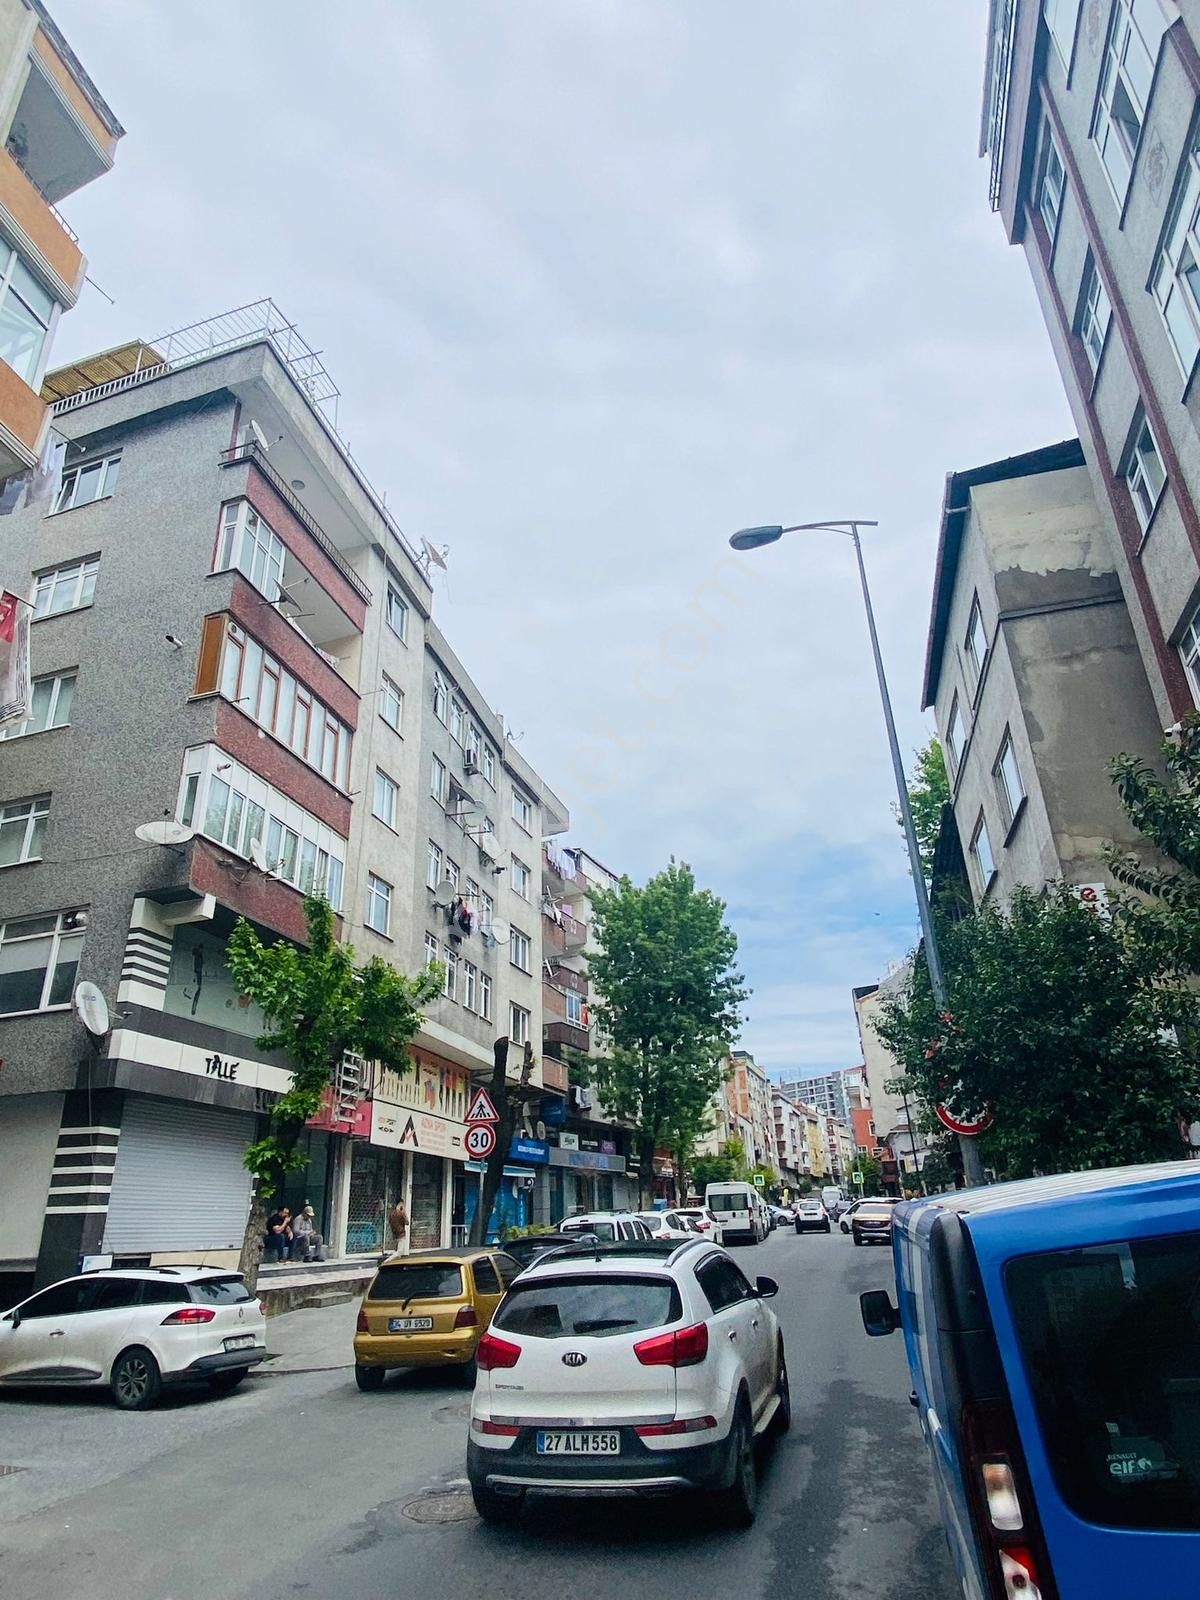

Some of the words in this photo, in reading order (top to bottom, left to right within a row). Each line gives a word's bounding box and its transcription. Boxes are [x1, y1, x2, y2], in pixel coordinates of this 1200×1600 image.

[470, 1132, 489, 1148] 30
[565, 1354, 584, 1364] KIA
[546, 1435, 562, 1451] 27
[592, 1435, 617, 1451] 558
[1110, 1460, 1135, 1475] elf
